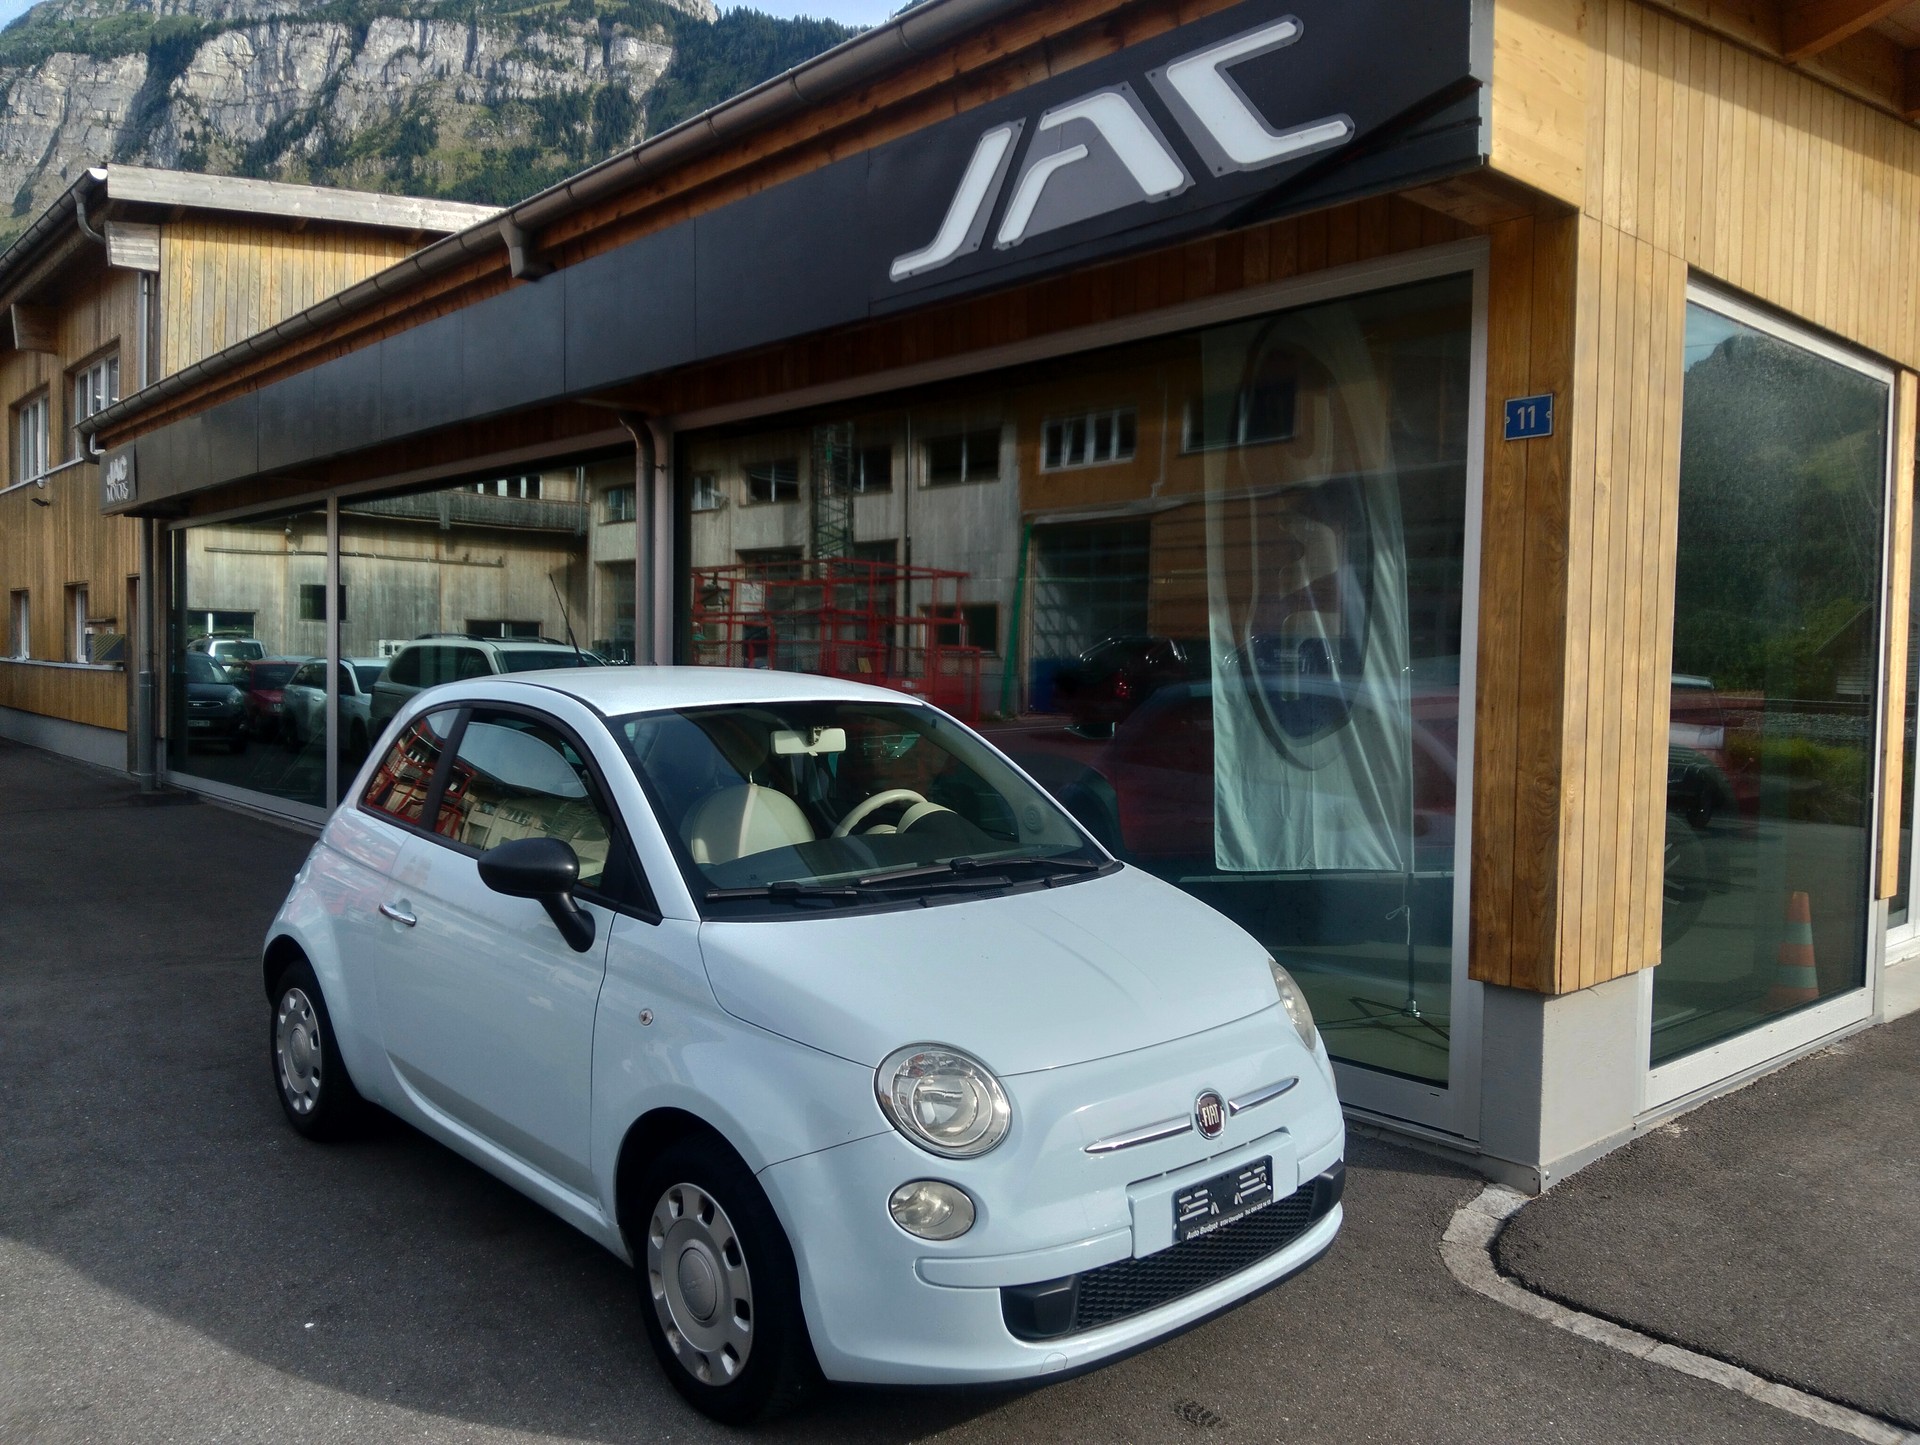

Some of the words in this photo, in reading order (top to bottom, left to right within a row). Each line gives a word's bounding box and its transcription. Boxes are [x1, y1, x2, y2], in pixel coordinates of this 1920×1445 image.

[890, 18, 1351, 278] JAC
[1517, 405, 1536, 430] 11
[106, 454, 128, 486] JAC
[1201, 1103, 1220, 1127] FIAT
[1186, 1229, 1200, 1240] Auto
[1200, 1221, 1219, 1235] Budget
